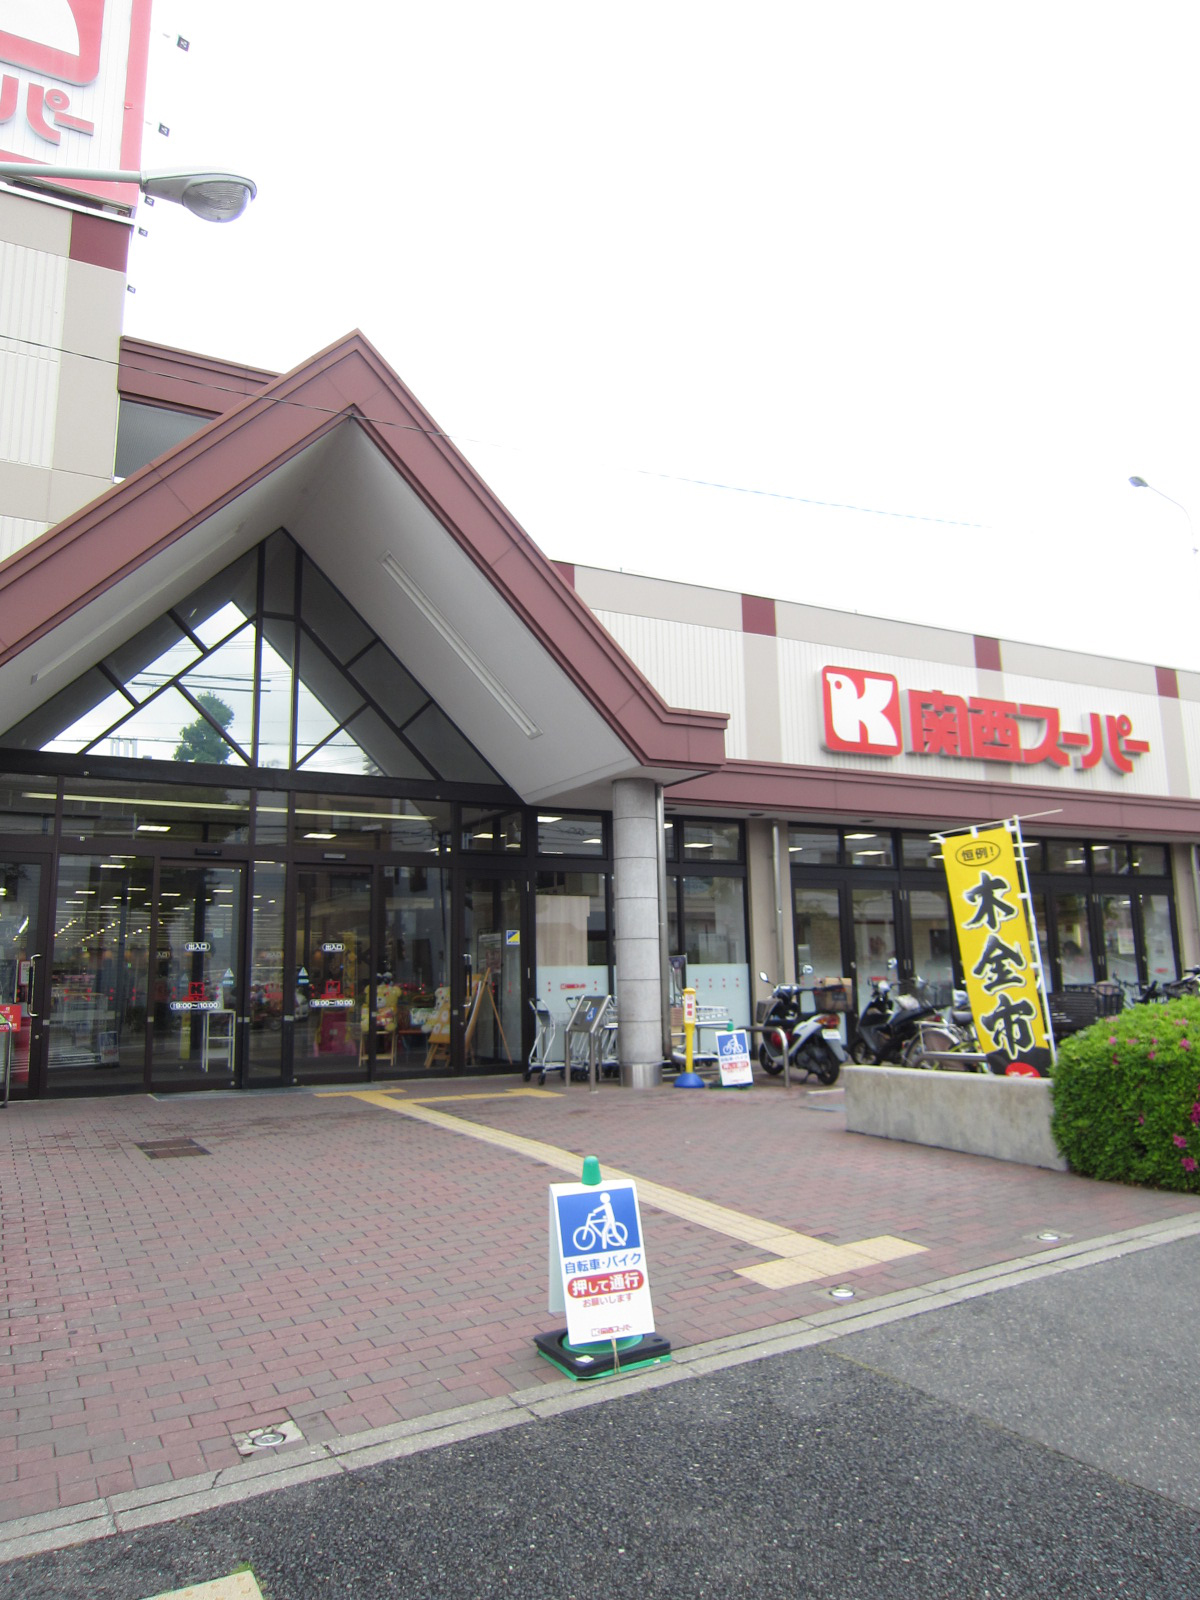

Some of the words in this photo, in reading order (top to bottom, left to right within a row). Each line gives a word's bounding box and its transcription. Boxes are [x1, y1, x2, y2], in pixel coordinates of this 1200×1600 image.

[905, 688, 1150, 774] 関西スーパー
[961, 870, 1038, 1060] 木金市
[565, 1253, 641, 1274] 自転車・バイク
[572, 1272, 640, 1296] 押して通行
[583, 1293, 633, 1308] お願いします
